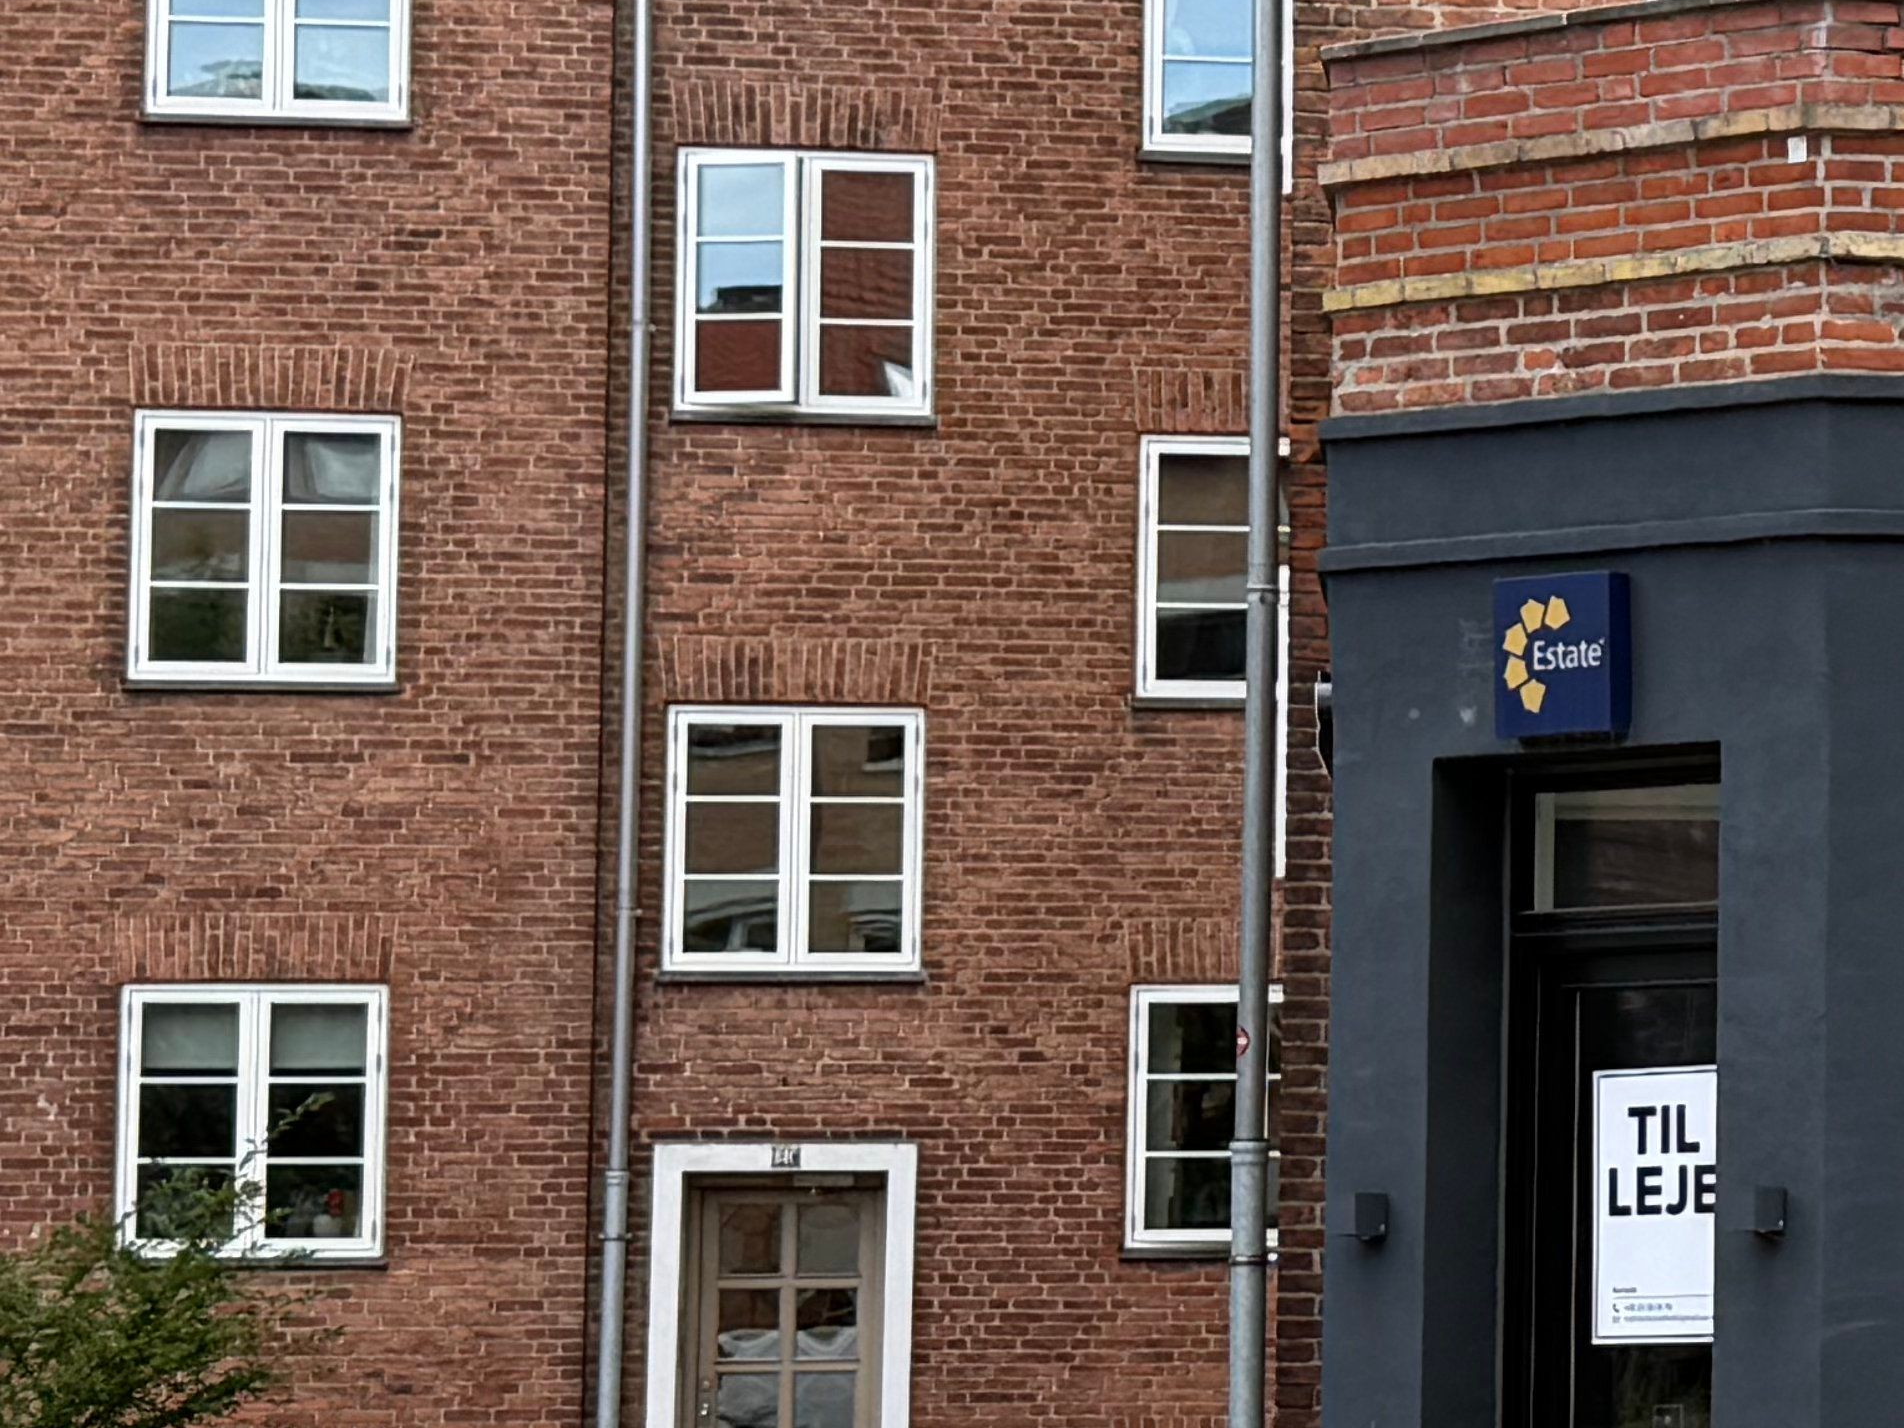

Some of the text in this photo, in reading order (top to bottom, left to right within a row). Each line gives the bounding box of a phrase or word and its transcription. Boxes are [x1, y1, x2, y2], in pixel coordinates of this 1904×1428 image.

[1533, 639, 1602, 671] Estate
[1627, 1104, 1700, 1155] TIL
[1609, 1165, 1717, 1217] LEJE
